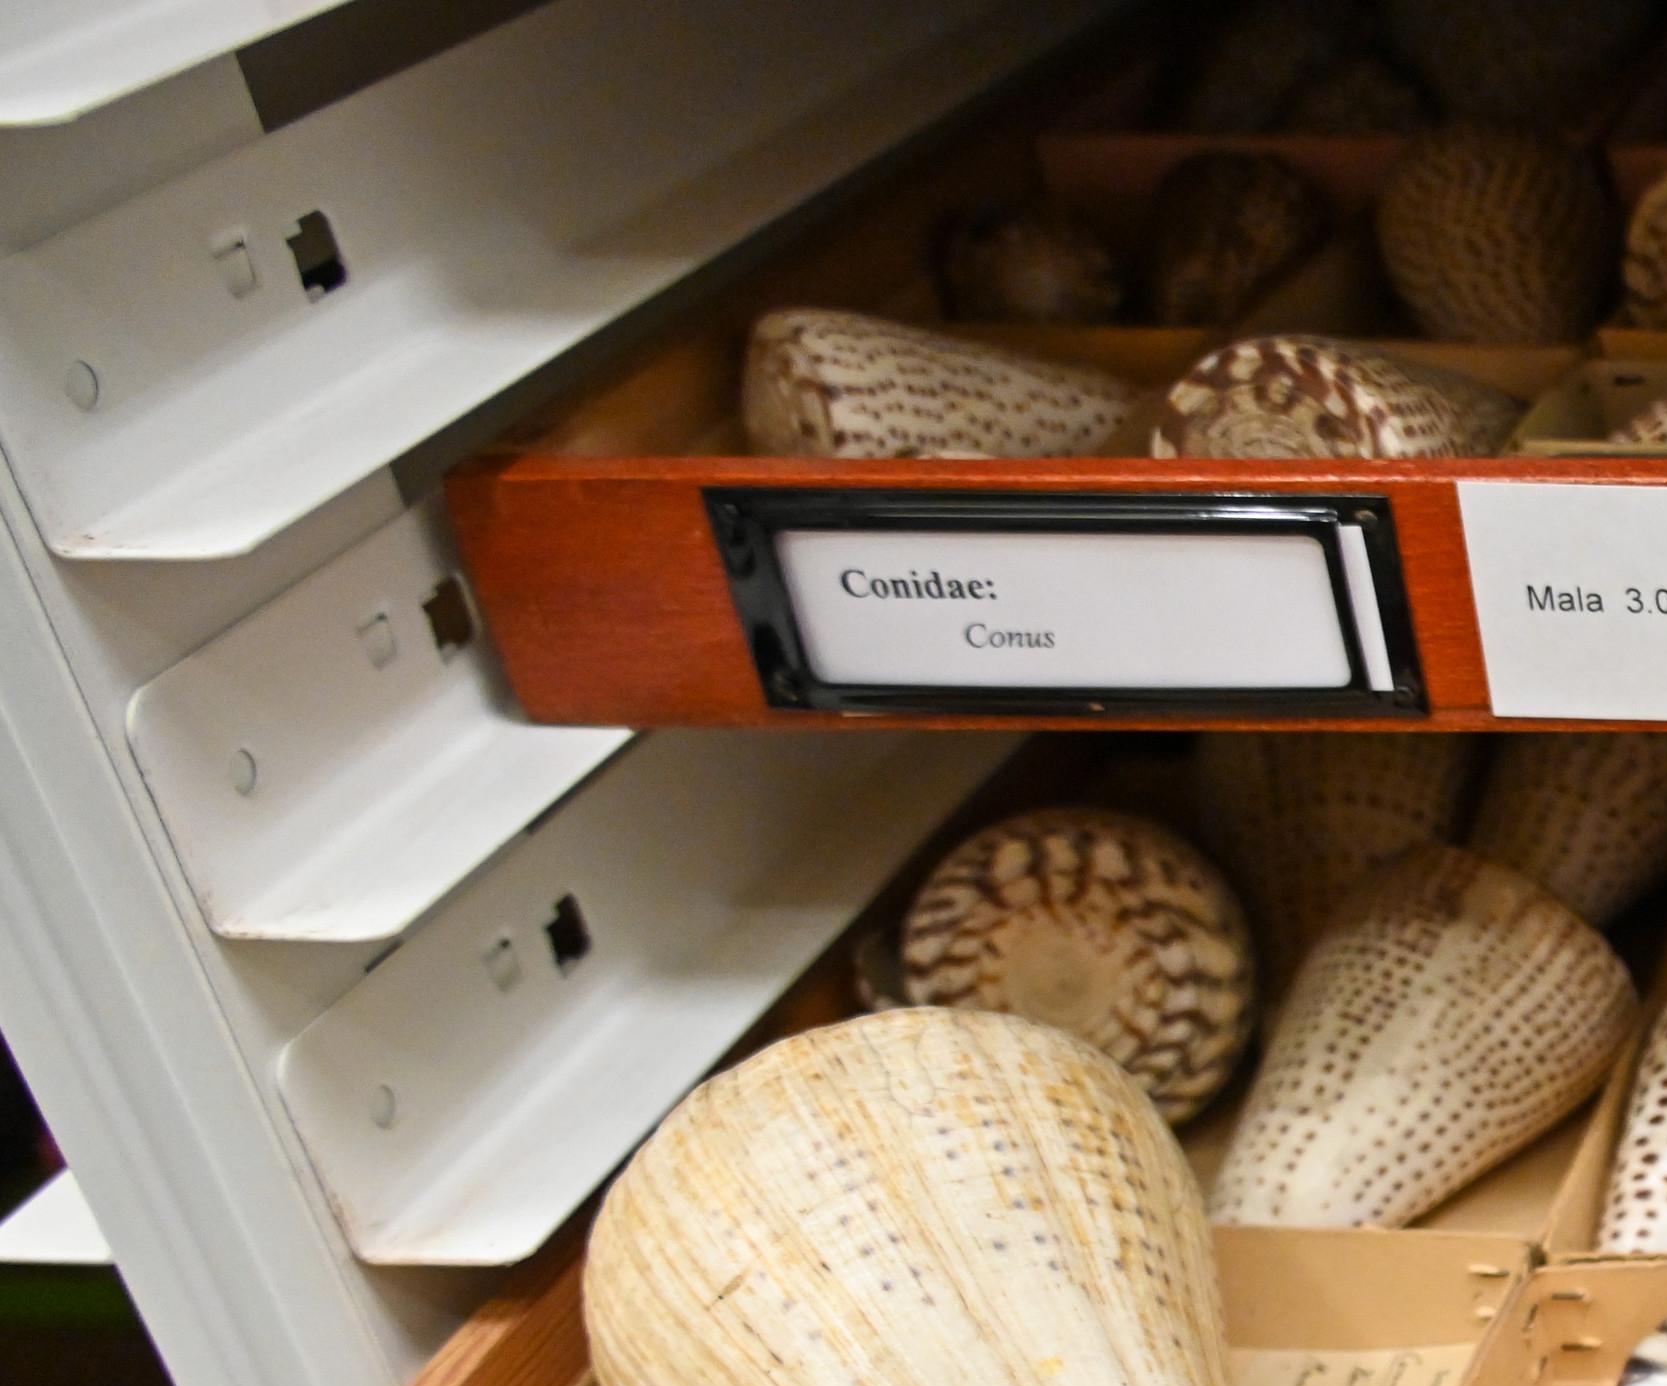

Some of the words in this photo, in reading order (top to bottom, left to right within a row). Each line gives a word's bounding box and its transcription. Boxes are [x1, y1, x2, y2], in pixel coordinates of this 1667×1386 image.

[840, 568, 998, 600] Conidae:
[1526, 584, 1604, 613] Mala
[963, 623, 1056, 649] Conus
